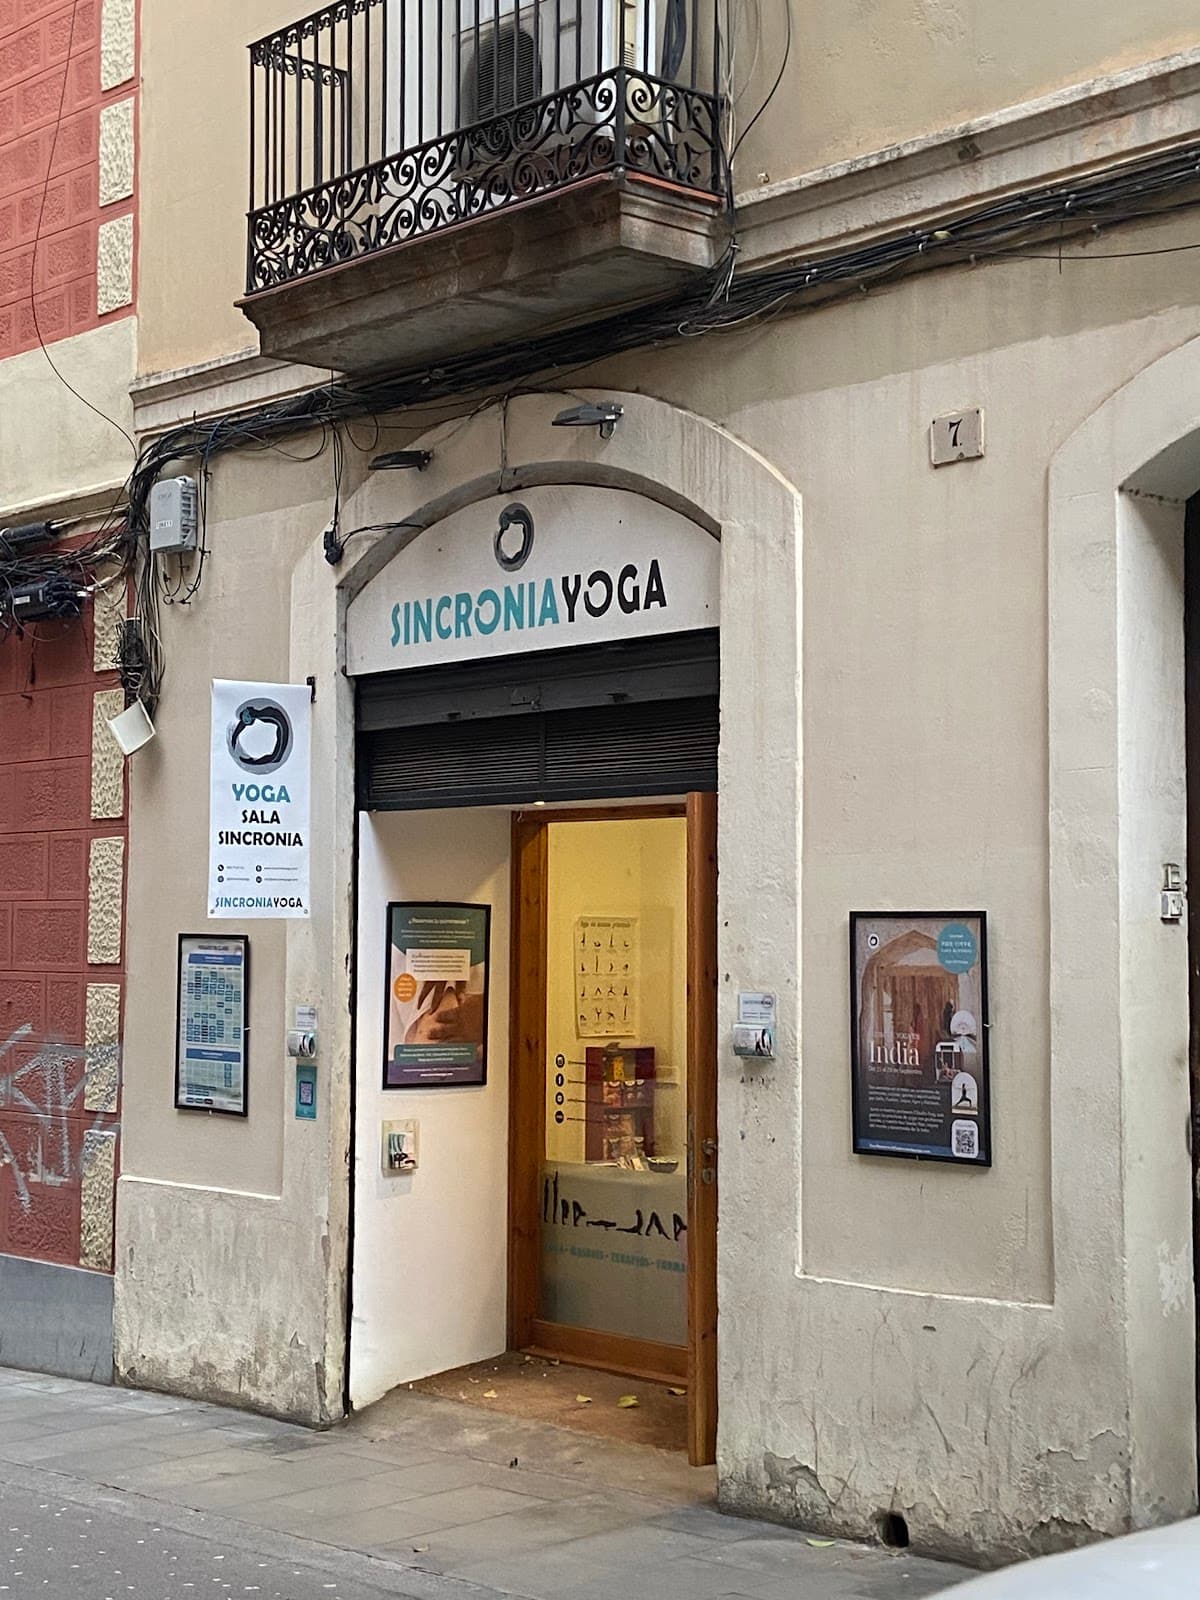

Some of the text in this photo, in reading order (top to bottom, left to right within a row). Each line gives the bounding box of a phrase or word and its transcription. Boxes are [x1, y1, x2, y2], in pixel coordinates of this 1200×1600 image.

[231, 783, 291, 803] YOGA
[241, 809, 281, 825] SALA
[218, 831, 303, 847] SINCRONIA
[870, 1040, 920, 1066] India
